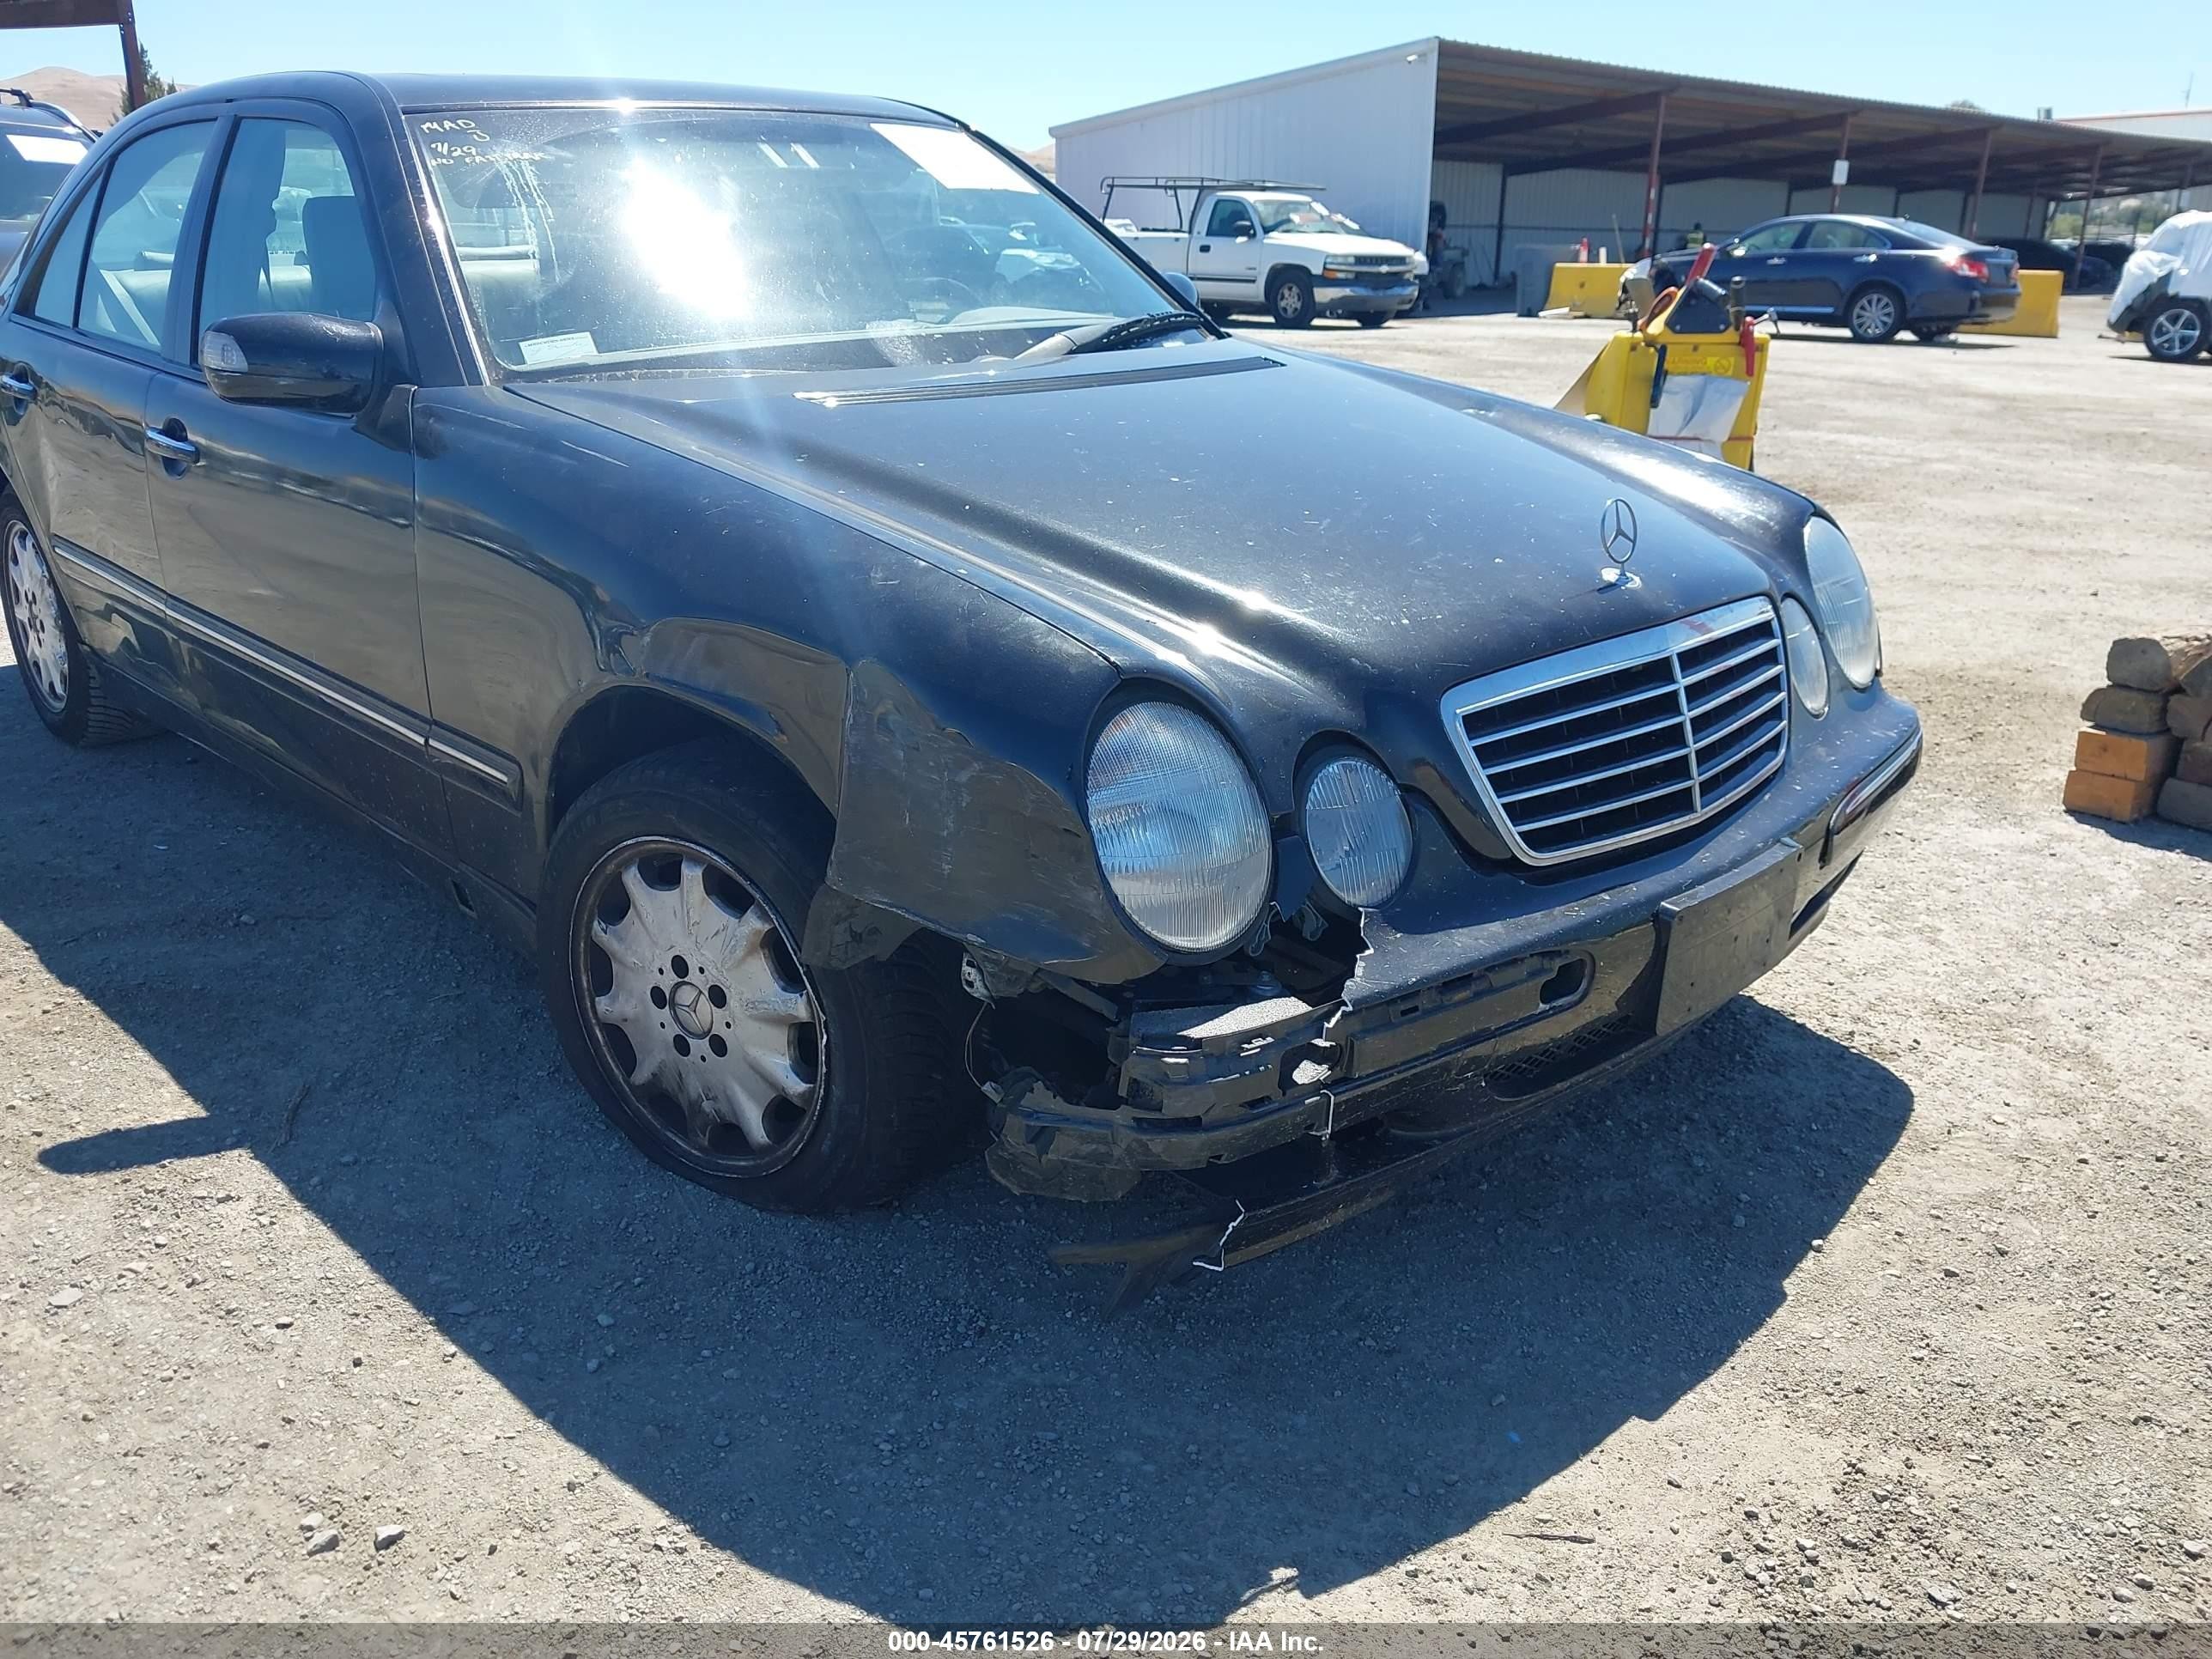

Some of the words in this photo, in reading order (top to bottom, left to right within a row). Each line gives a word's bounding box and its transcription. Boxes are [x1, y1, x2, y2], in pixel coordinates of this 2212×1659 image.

[420, 118, 476, 134] MAD
[430, 142, 477, 157] 7/29
[430, 157, 454, 166] NO
